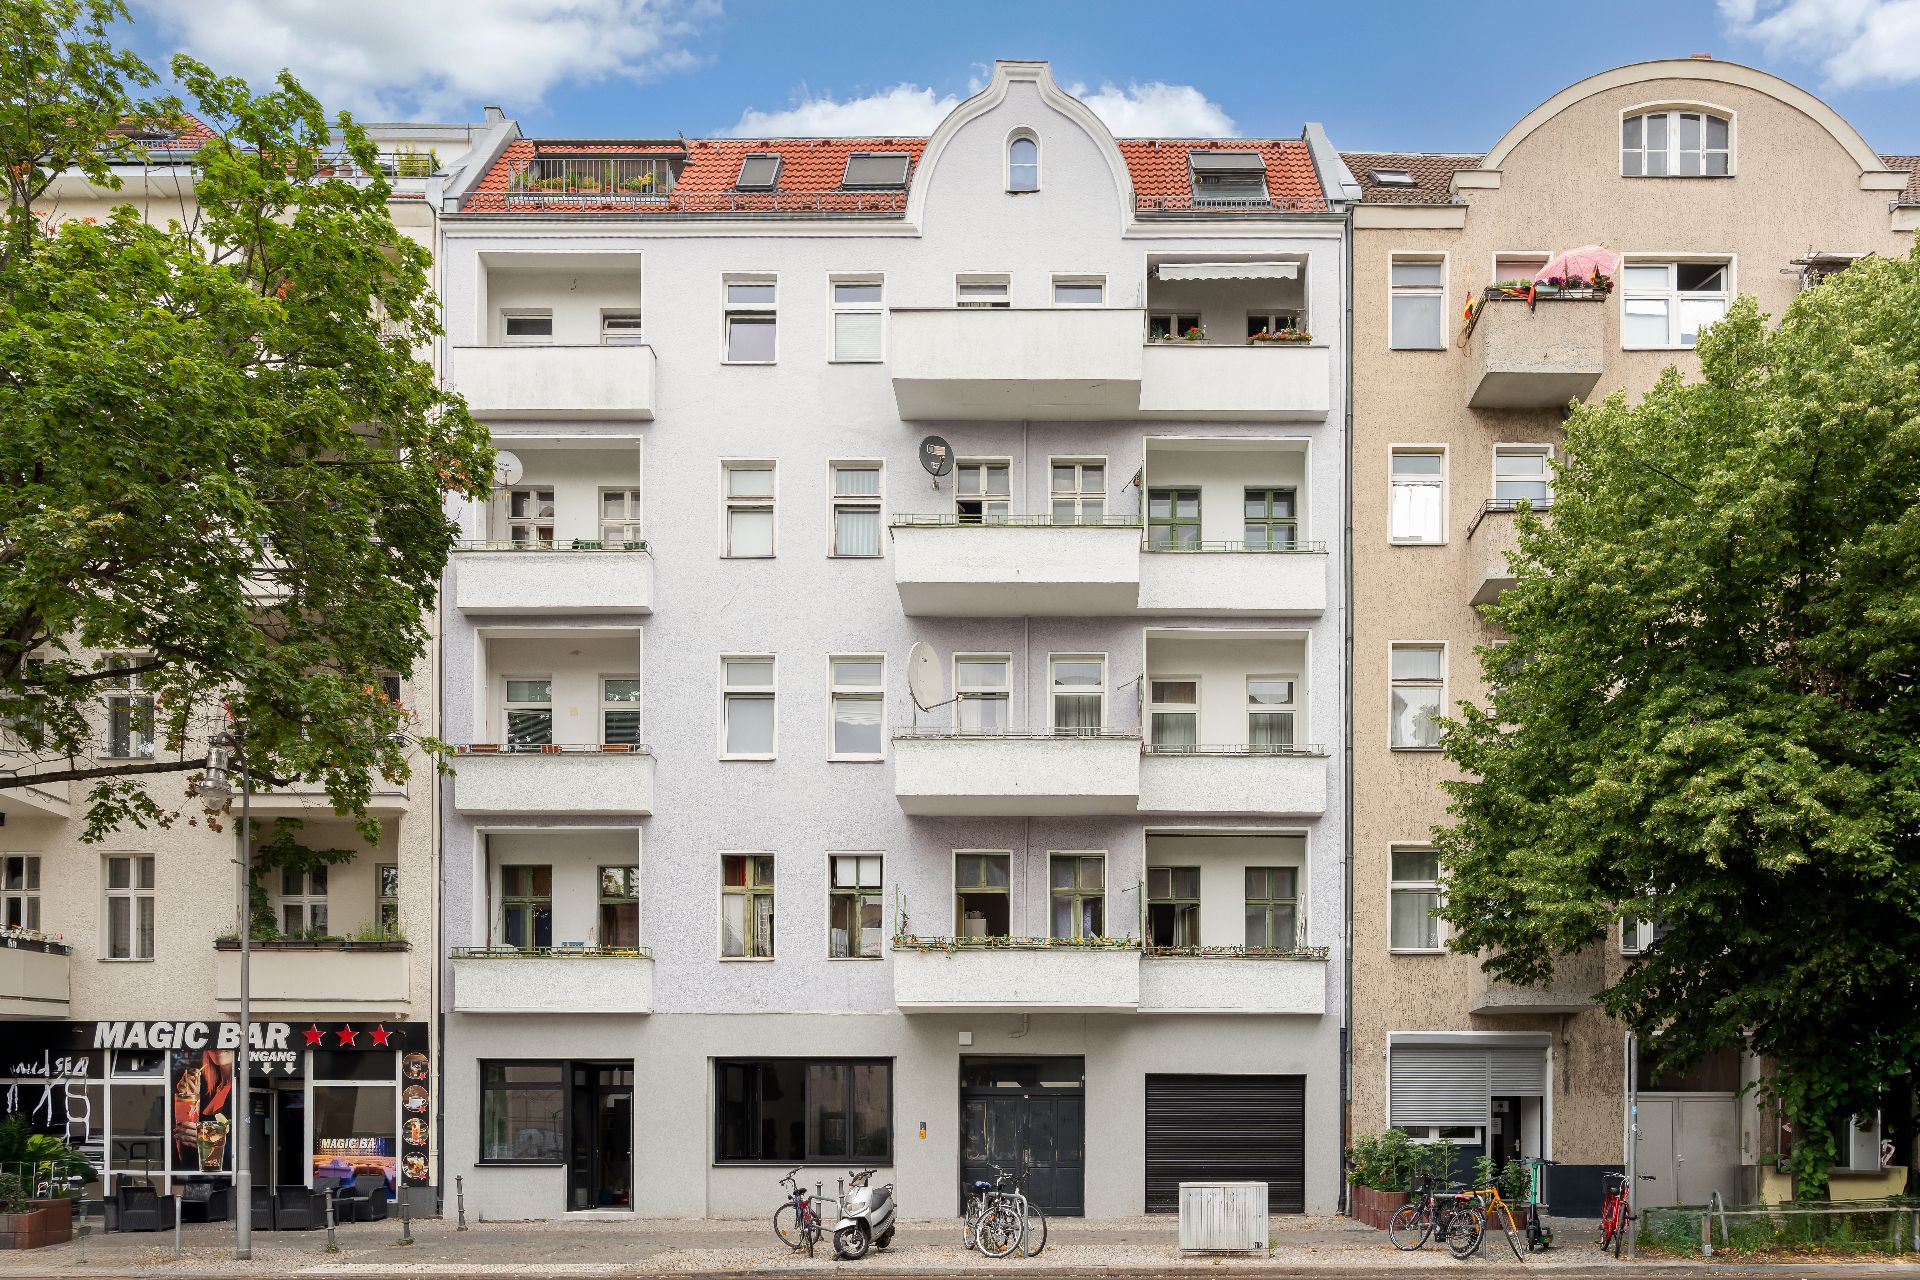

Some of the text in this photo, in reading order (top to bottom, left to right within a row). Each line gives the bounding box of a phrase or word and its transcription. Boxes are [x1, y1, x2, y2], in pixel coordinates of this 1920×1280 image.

[93, 1021, 210, 1049] MAGIC
[238, 1051, 297, 1062] NGANG
[321, 1138, 357, 1149] MAGIC
